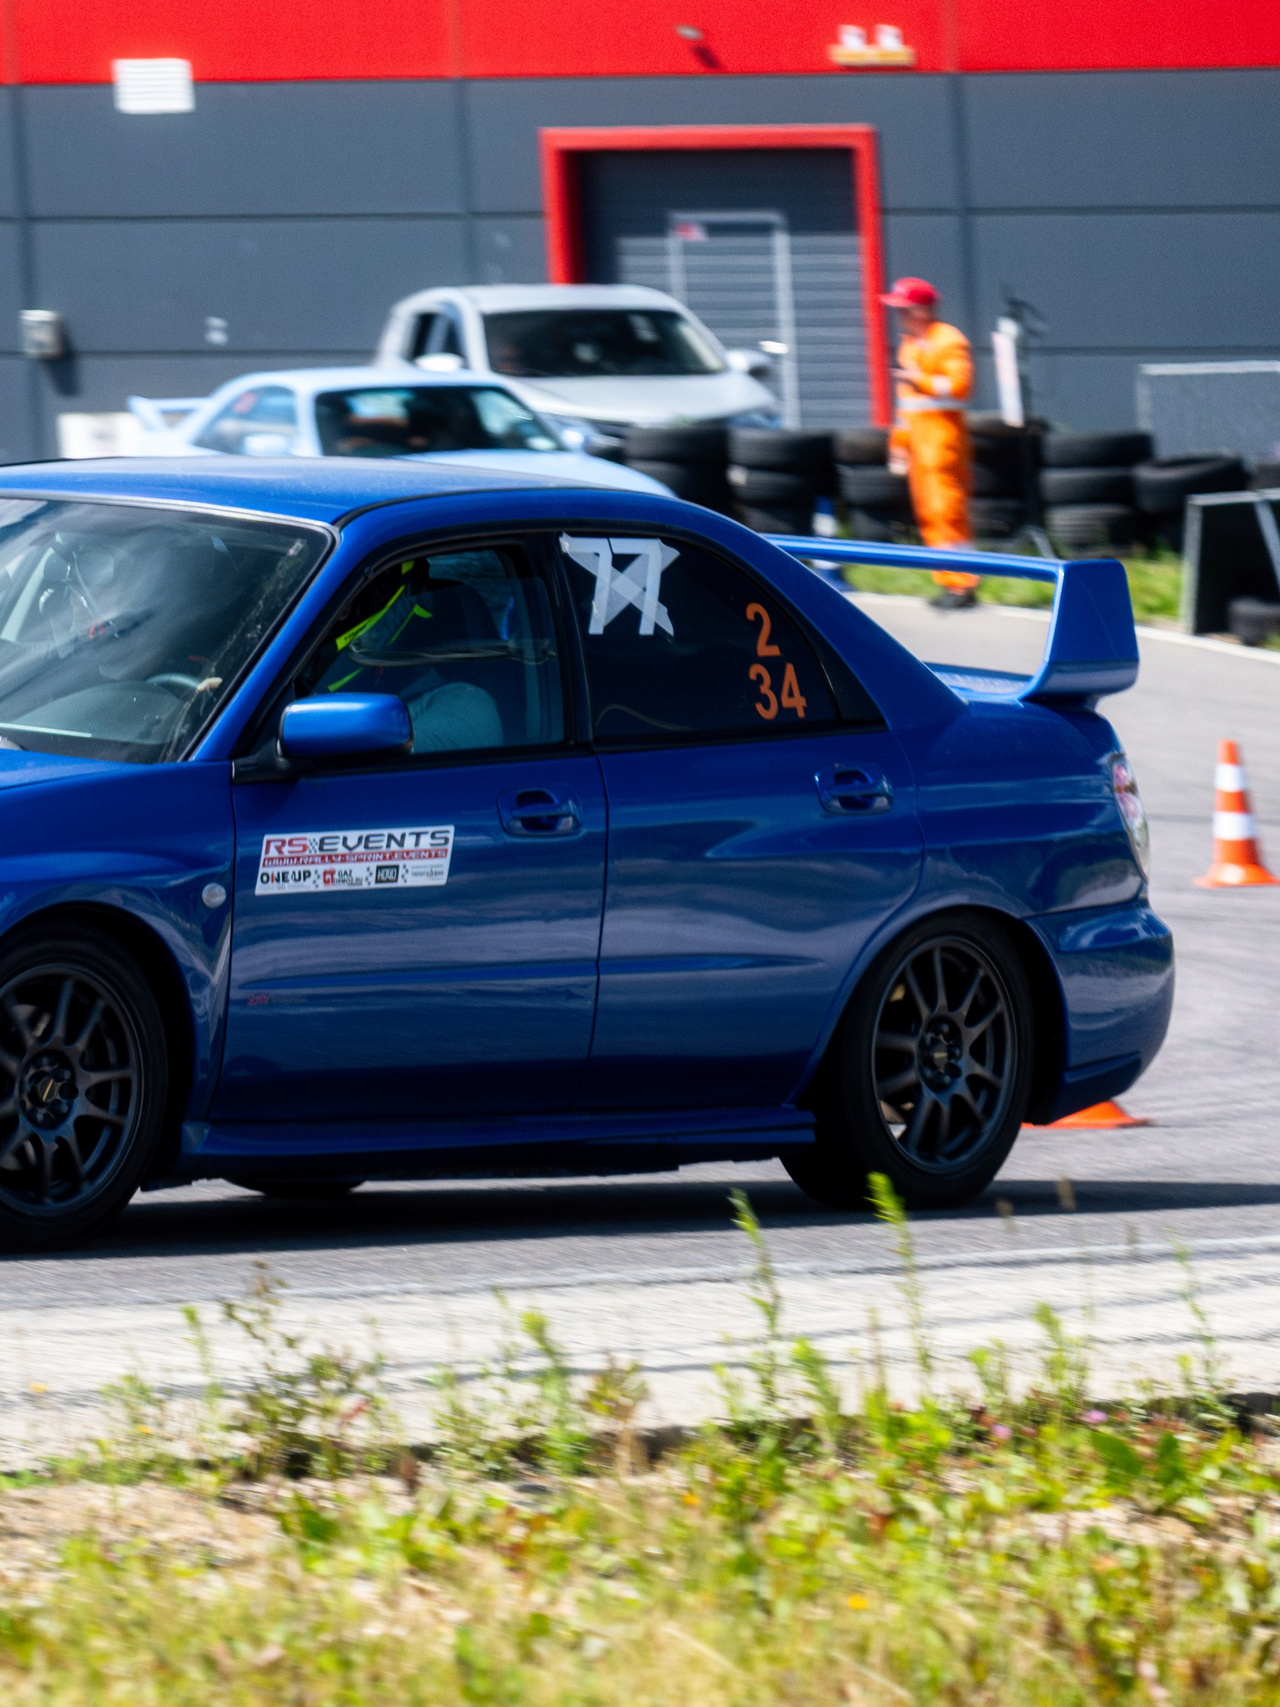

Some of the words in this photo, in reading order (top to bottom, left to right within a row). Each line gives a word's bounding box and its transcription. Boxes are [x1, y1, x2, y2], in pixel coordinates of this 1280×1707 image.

[745, 602, 781, 657] 2
[748, 662, 807, 721] 34
[264, 836, 309, 855] RS
[318, 830, 451, 852] EVENTS
